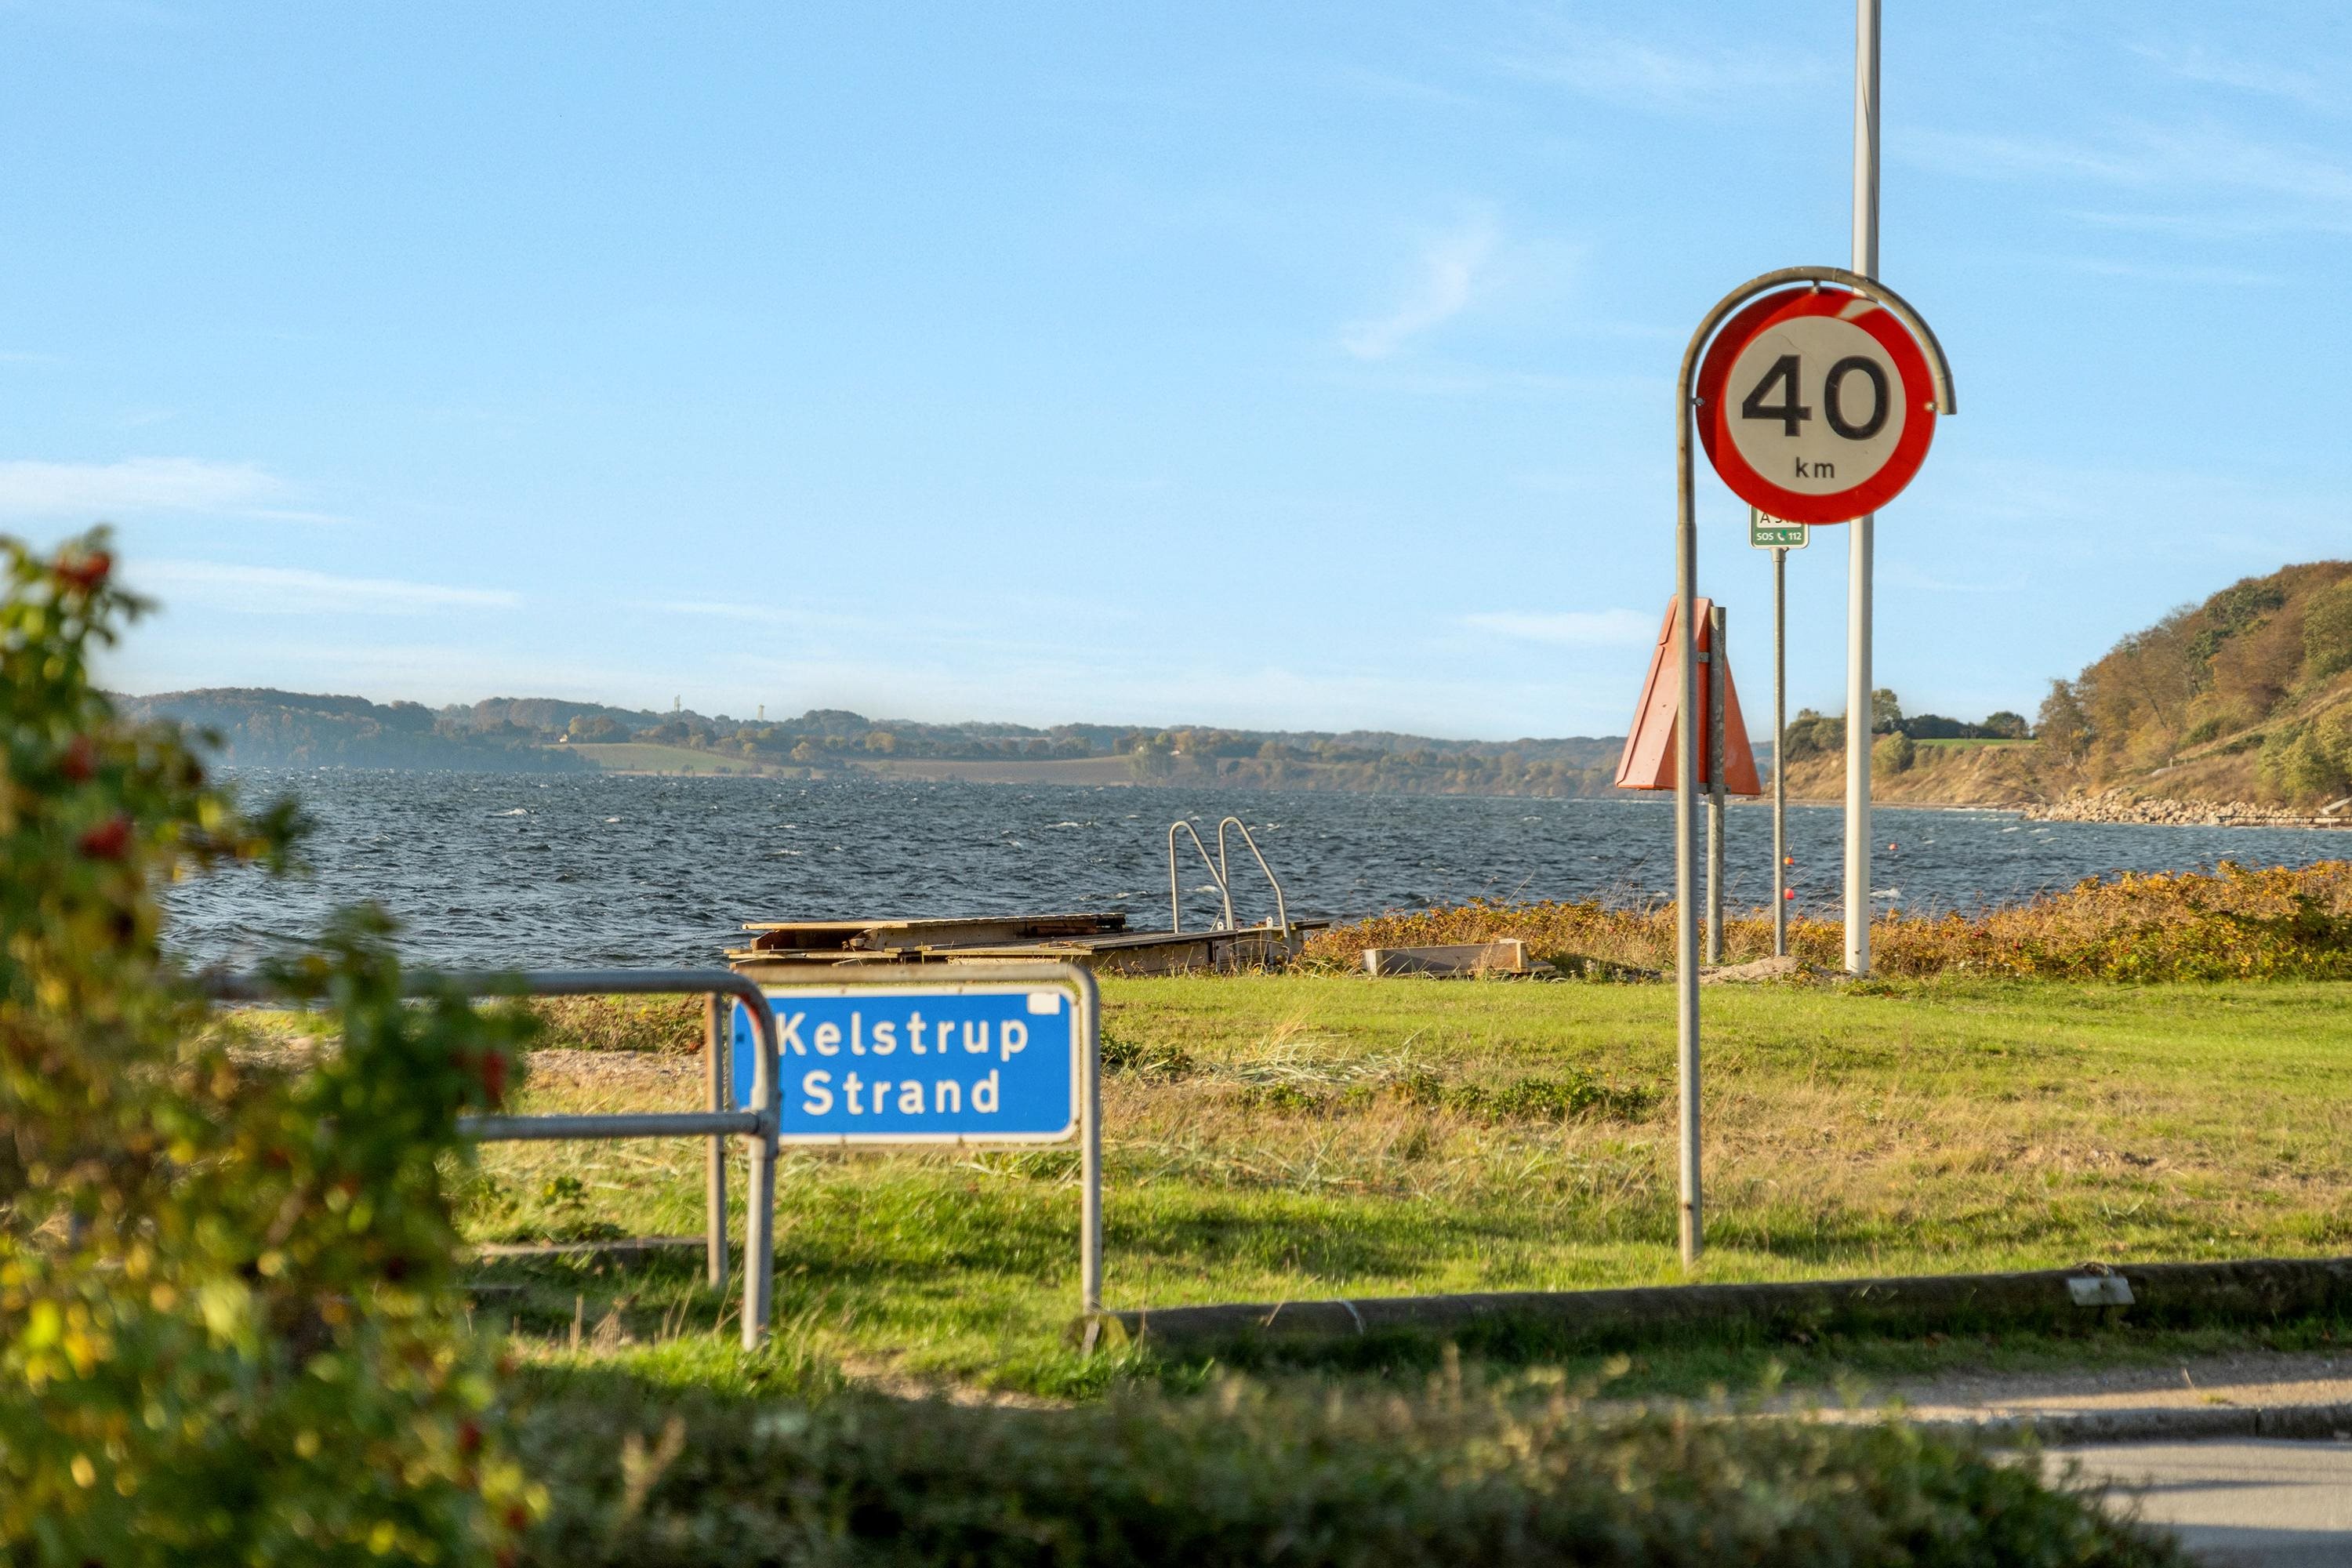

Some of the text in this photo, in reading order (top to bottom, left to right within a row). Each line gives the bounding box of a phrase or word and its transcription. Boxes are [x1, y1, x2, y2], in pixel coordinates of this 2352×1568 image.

[1742, 354, 1890, 441] 40
[1795, 457, 1835, 478] km
[1756, 532, 1802, 541] SOS 112
[776, 1011, 1029, 1062] Kelstrup
[802, 1069, 1000, 1116] Strand
